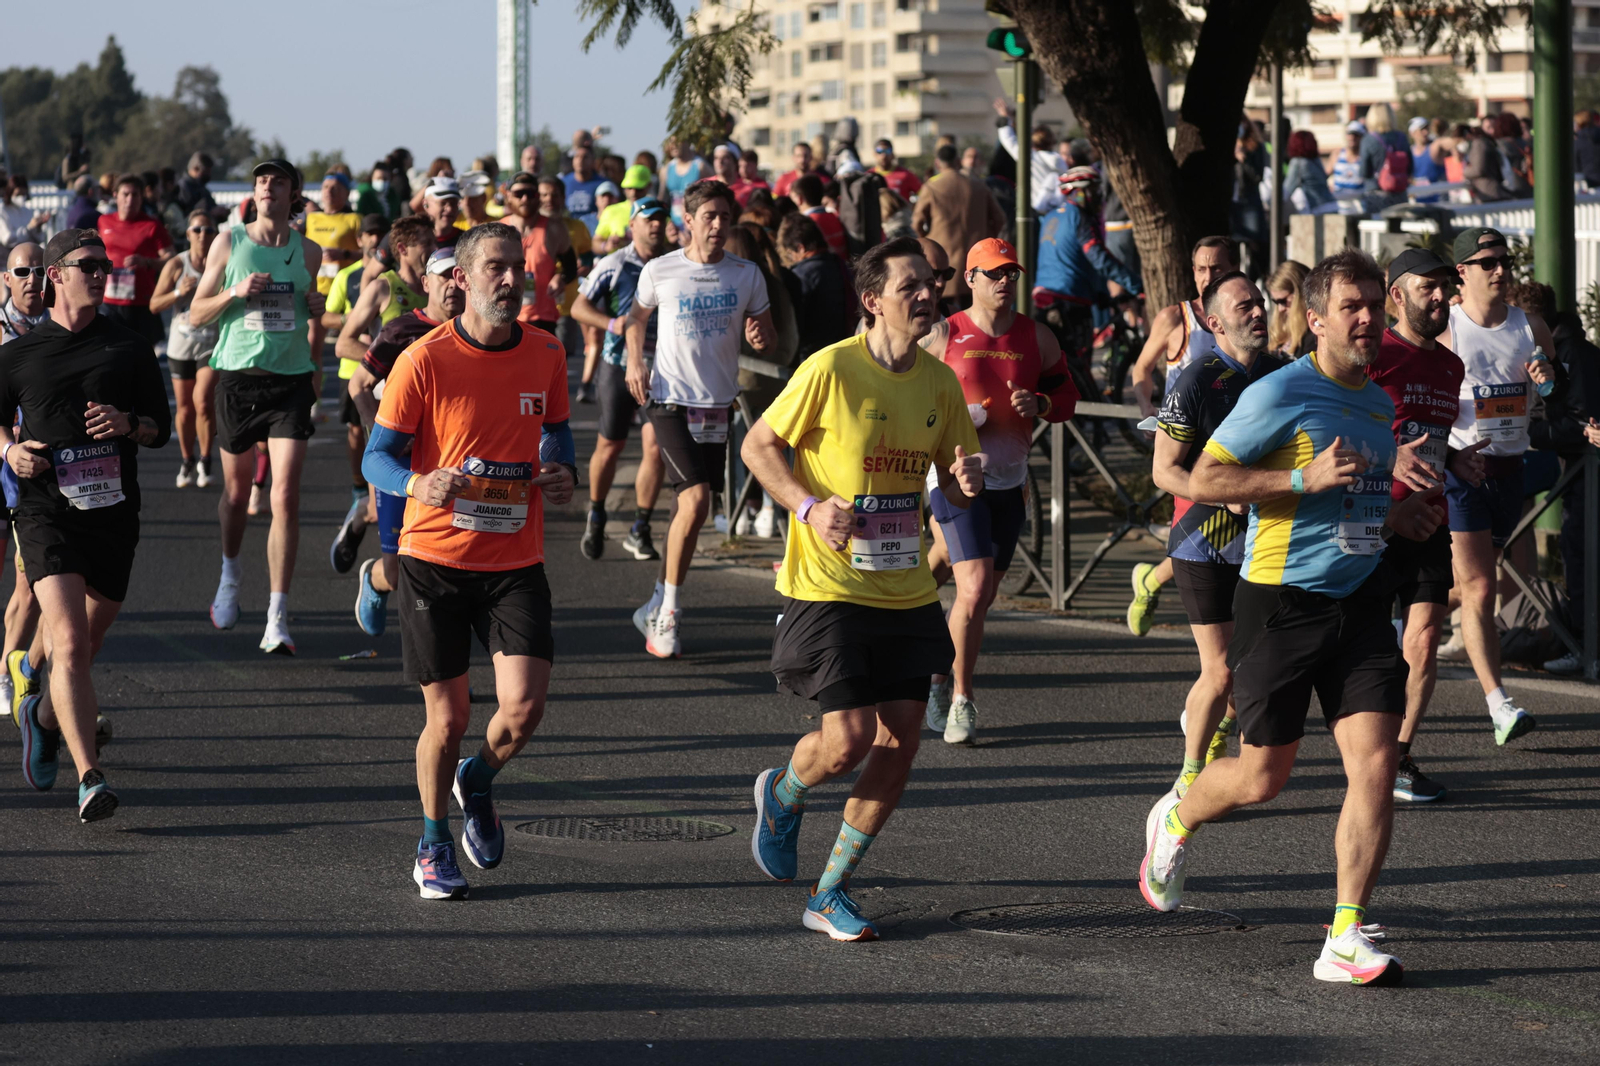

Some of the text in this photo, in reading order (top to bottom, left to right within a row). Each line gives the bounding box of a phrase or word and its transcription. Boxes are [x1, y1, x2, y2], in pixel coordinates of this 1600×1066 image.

[266, 283, 289, 292] URICH
[260, 299, 279, 308] 9130
[679, 293, 738, 312] MADRID
[674, 315, 731, 336] MADRID
[962, 349, 1024, 361] ESPAÑA
[1493, 386, 1524, 396] ZURICH
[1499, 419, 1513, 427] JAVI
[1420, 426, 1447, 438] ZURICH
[77, 445, 114, 458] ZURICH
[1418, 445, 1437, 456] 9314
[80, 467, 104, 479] 7425
[487, 465, 524, 477] ZURICH
[79, 484, 102, 493] MITCH
[483, 487, 509, 500] 3650
[880, 497, 916, 510] ZURICH
[473, 504, 512, 516] JUANCDG
[880, 522, 902, 535] 6211
[1365, 526, 1382, 536] DIE
[881, 541, 901, 551] PEPO
